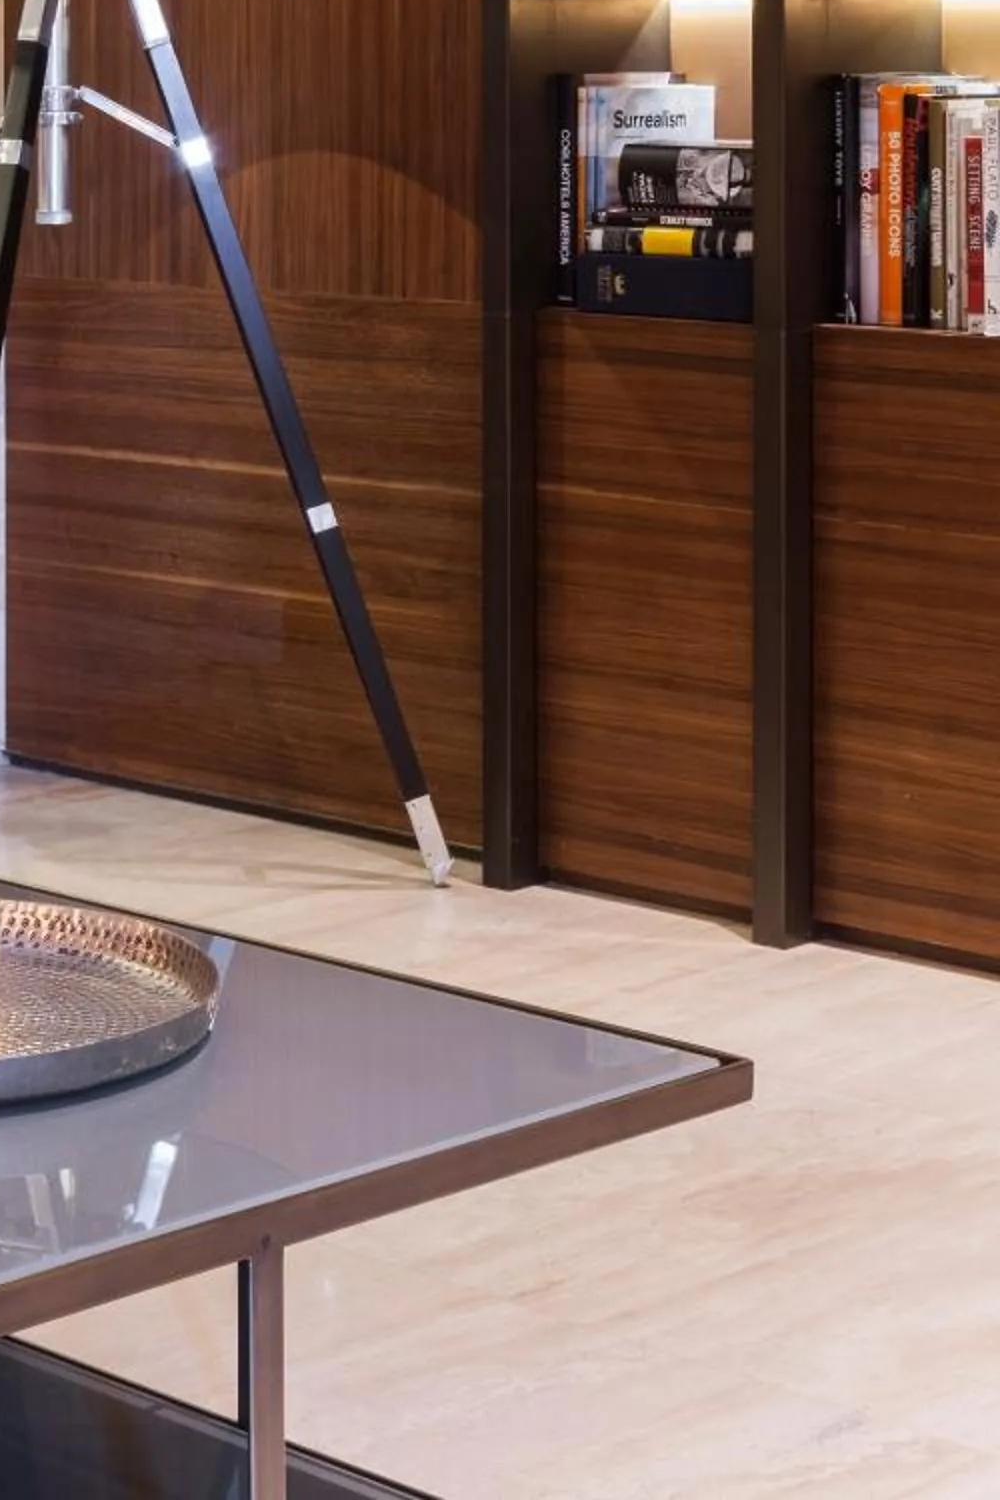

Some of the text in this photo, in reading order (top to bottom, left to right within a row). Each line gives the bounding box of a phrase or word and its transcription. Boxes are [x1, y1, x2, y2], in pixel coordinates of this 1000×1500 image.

[613, 109, 687, 129] Surrealism
[986, 117, 999, 201] PAUL FLATO
[888, 132, 902, 258] 50 PHOTO ICONS
[967, 154, 983, 252] SETTING SCENE
[559, 211, 571, 266] AMERICA
